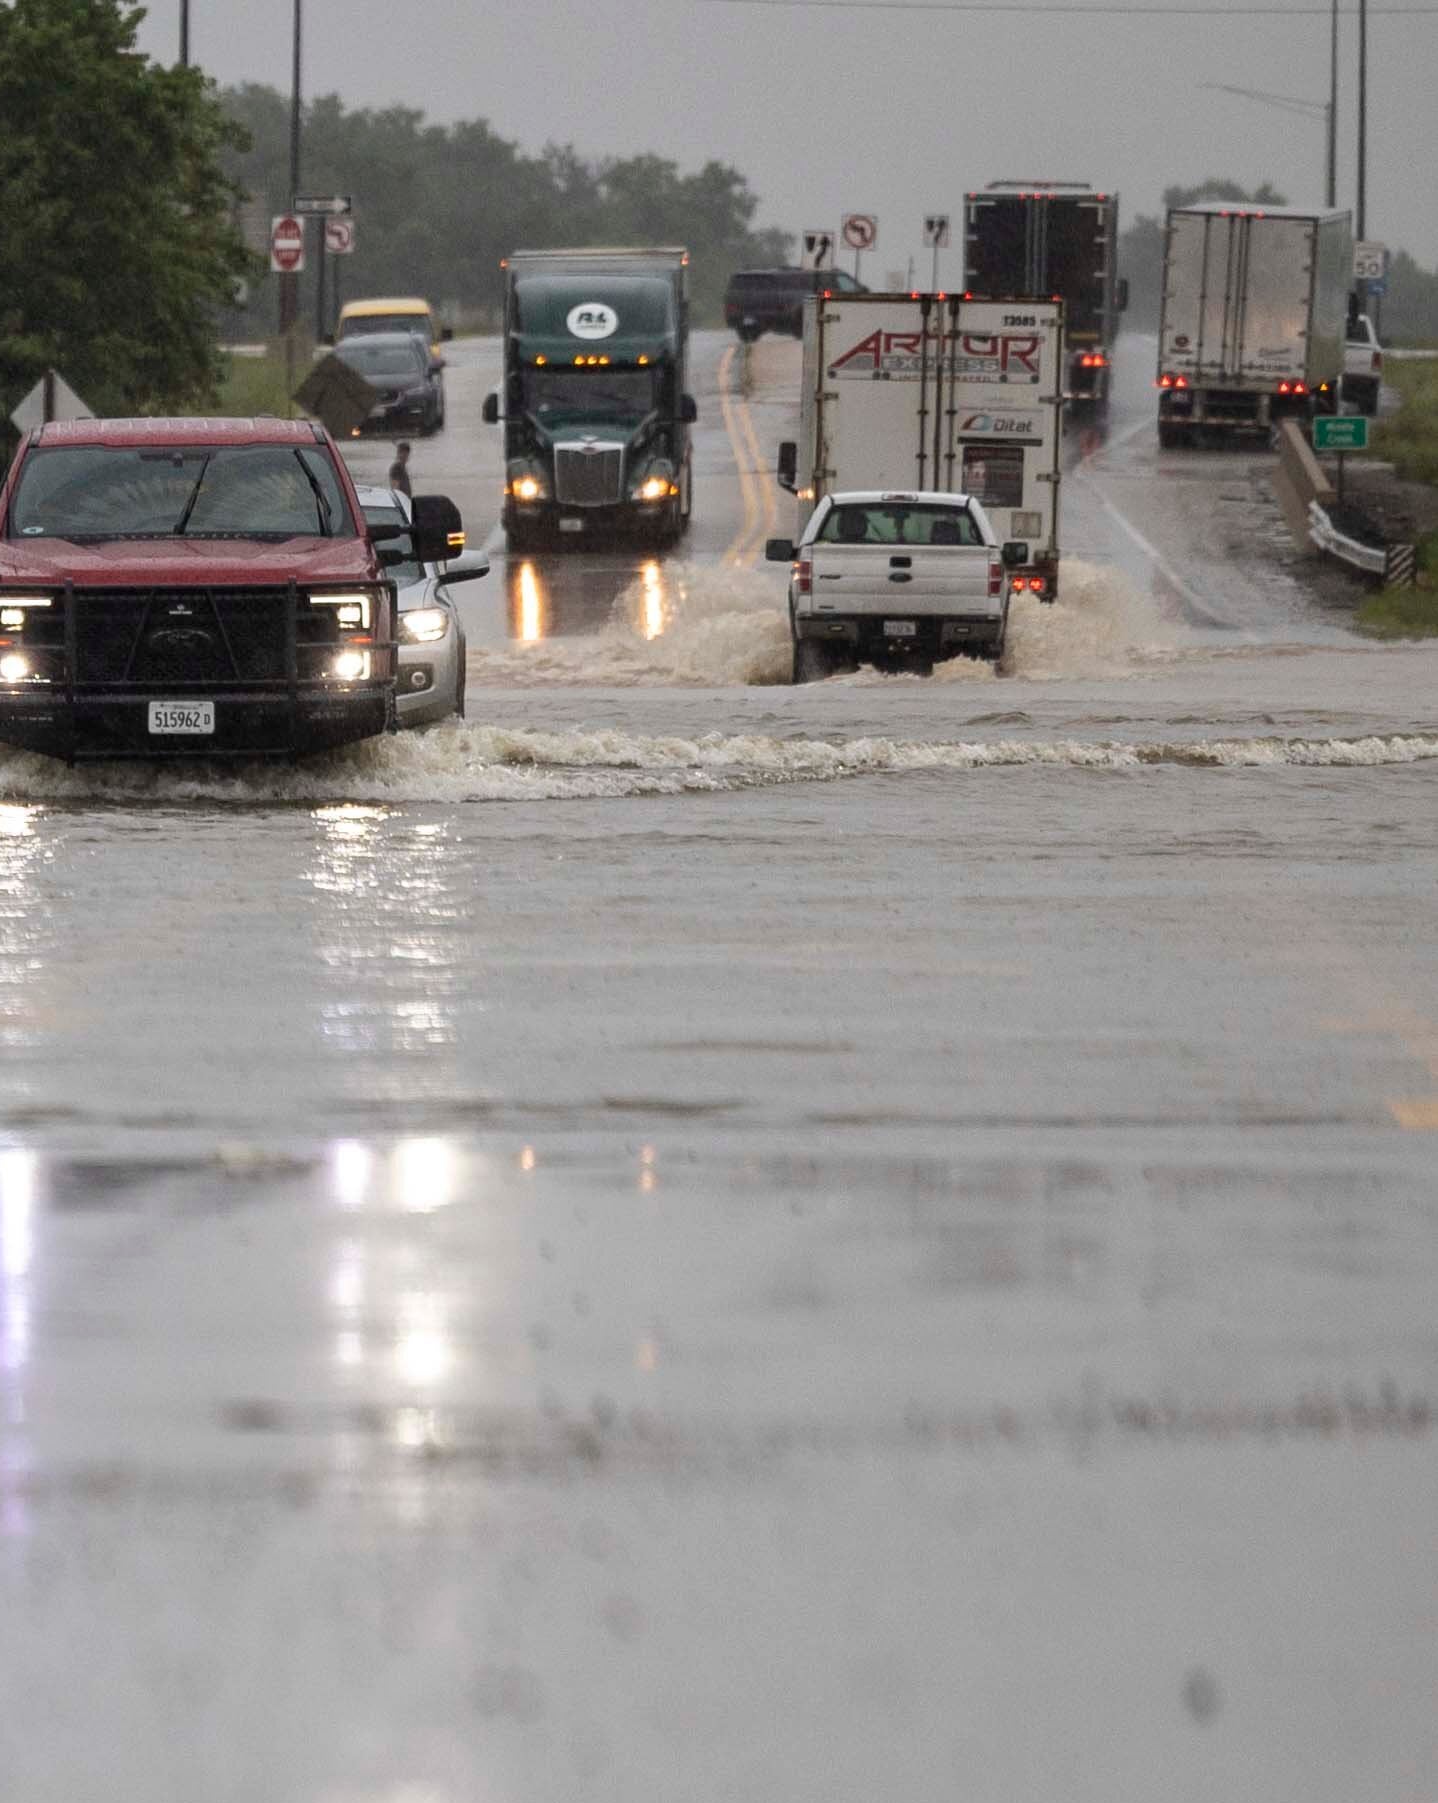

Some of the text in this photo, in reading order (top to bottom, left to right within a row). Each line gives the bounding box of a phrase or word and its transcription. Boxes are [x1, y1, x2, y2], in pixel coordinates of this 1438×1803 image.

[1356, 261, 1378, 276] 50
[993, 418, 1032, 433] Ditat
[155, 711, 211, 728] 515962 D
